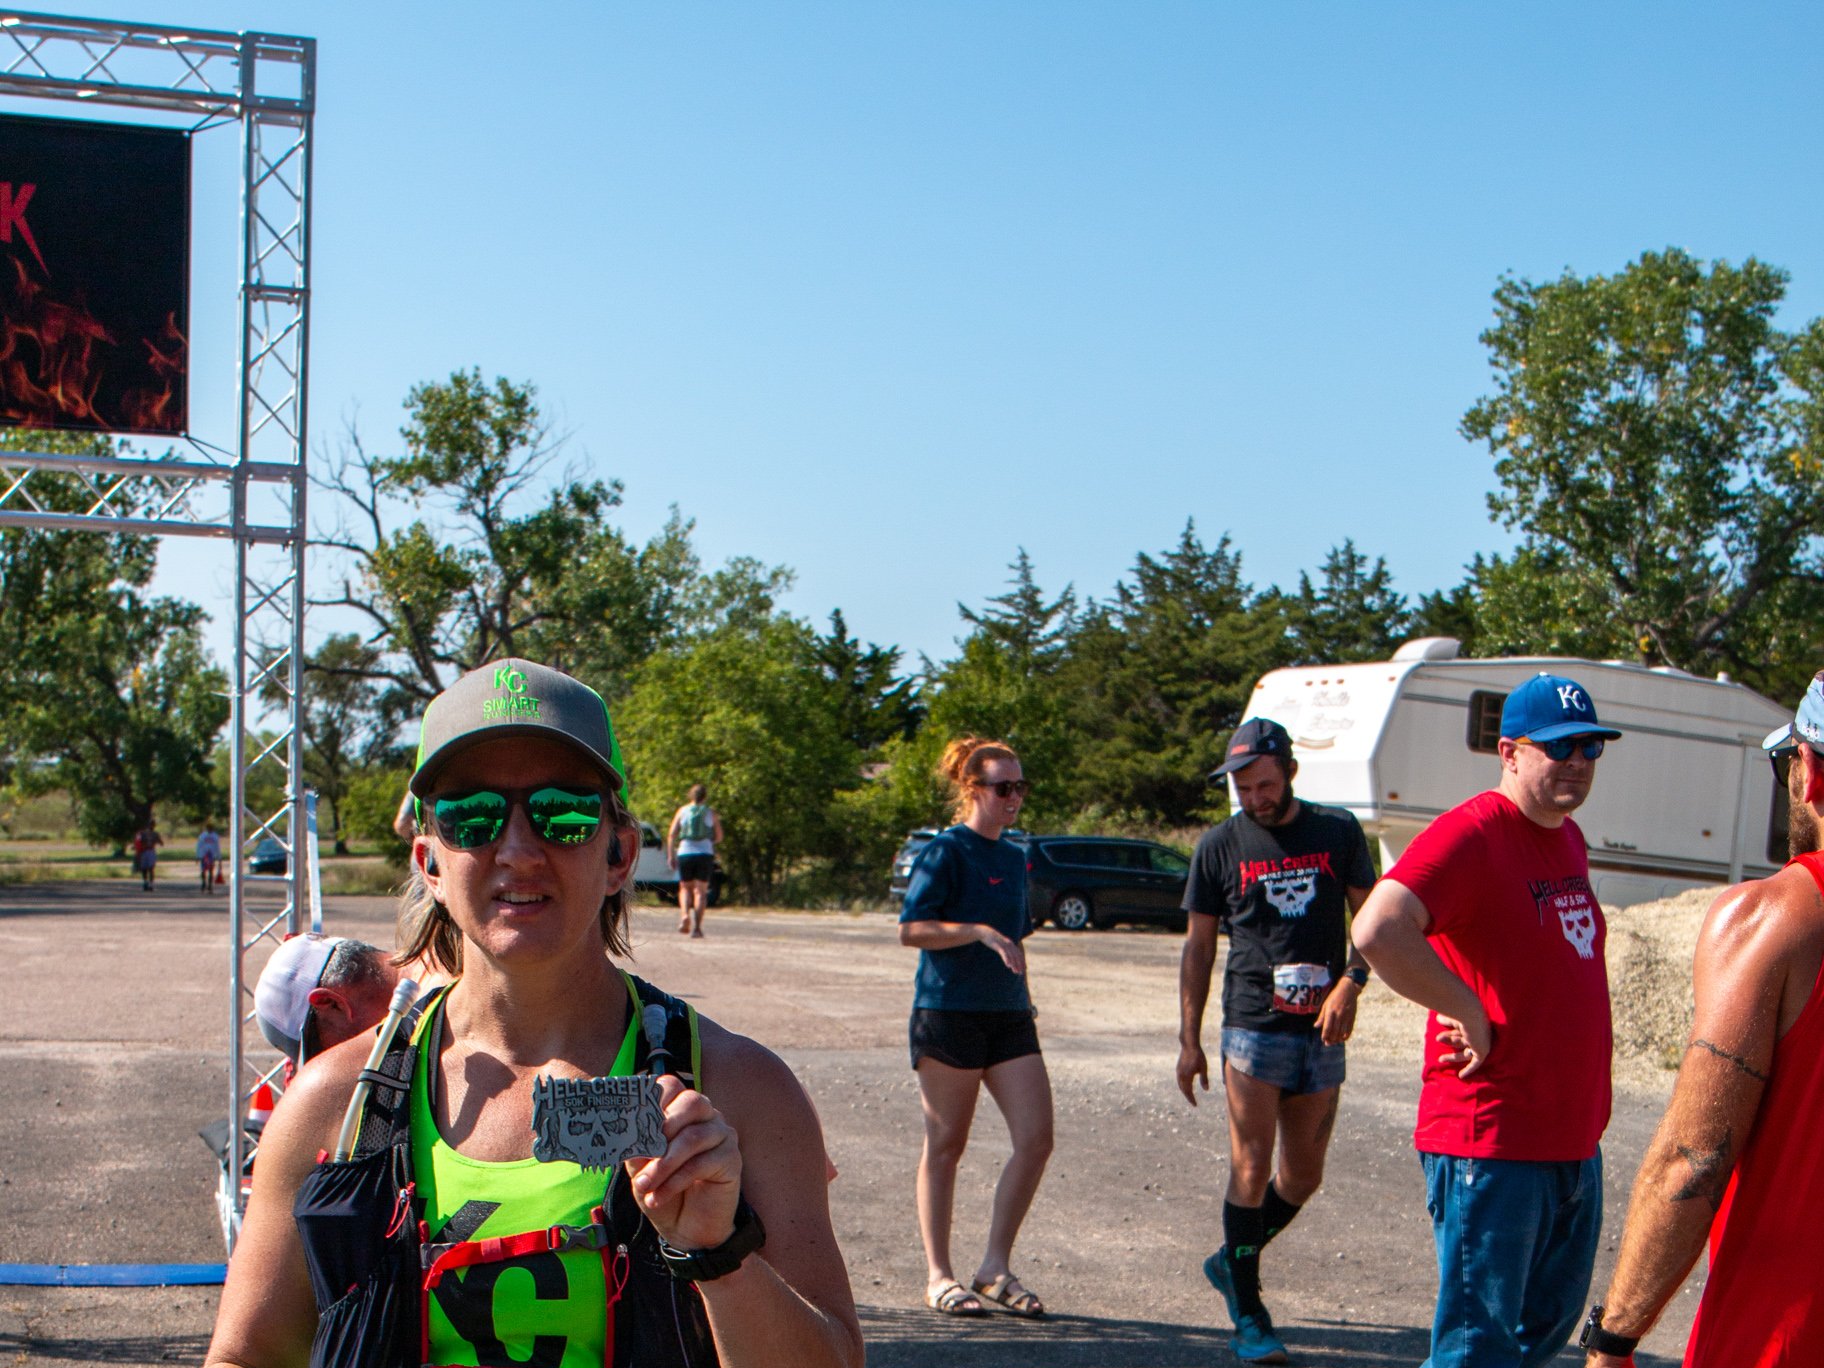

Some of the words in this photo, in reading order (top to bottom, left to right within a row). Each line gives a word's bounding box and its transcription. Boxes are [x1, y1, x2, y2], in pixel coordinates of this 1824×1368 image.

[493, 665, 528, 692] KC
[483, 696, 540, 712] SMART
[1557, 684, 1586, 712] KC
[1240, 860, 1279, 897] HELL
[1282, 852, 1336, 880] CREEK
[1527, 879, 1562, 926] HELL
[1285, 984, 1323, 1007] 238
[531, 1074, 586, 1131] HELL
[591, 1073, 664, 1120] CREEK
[564, 1097, 585, 1107] 50K
[587, 1095, 629, 1107] FINISHER
